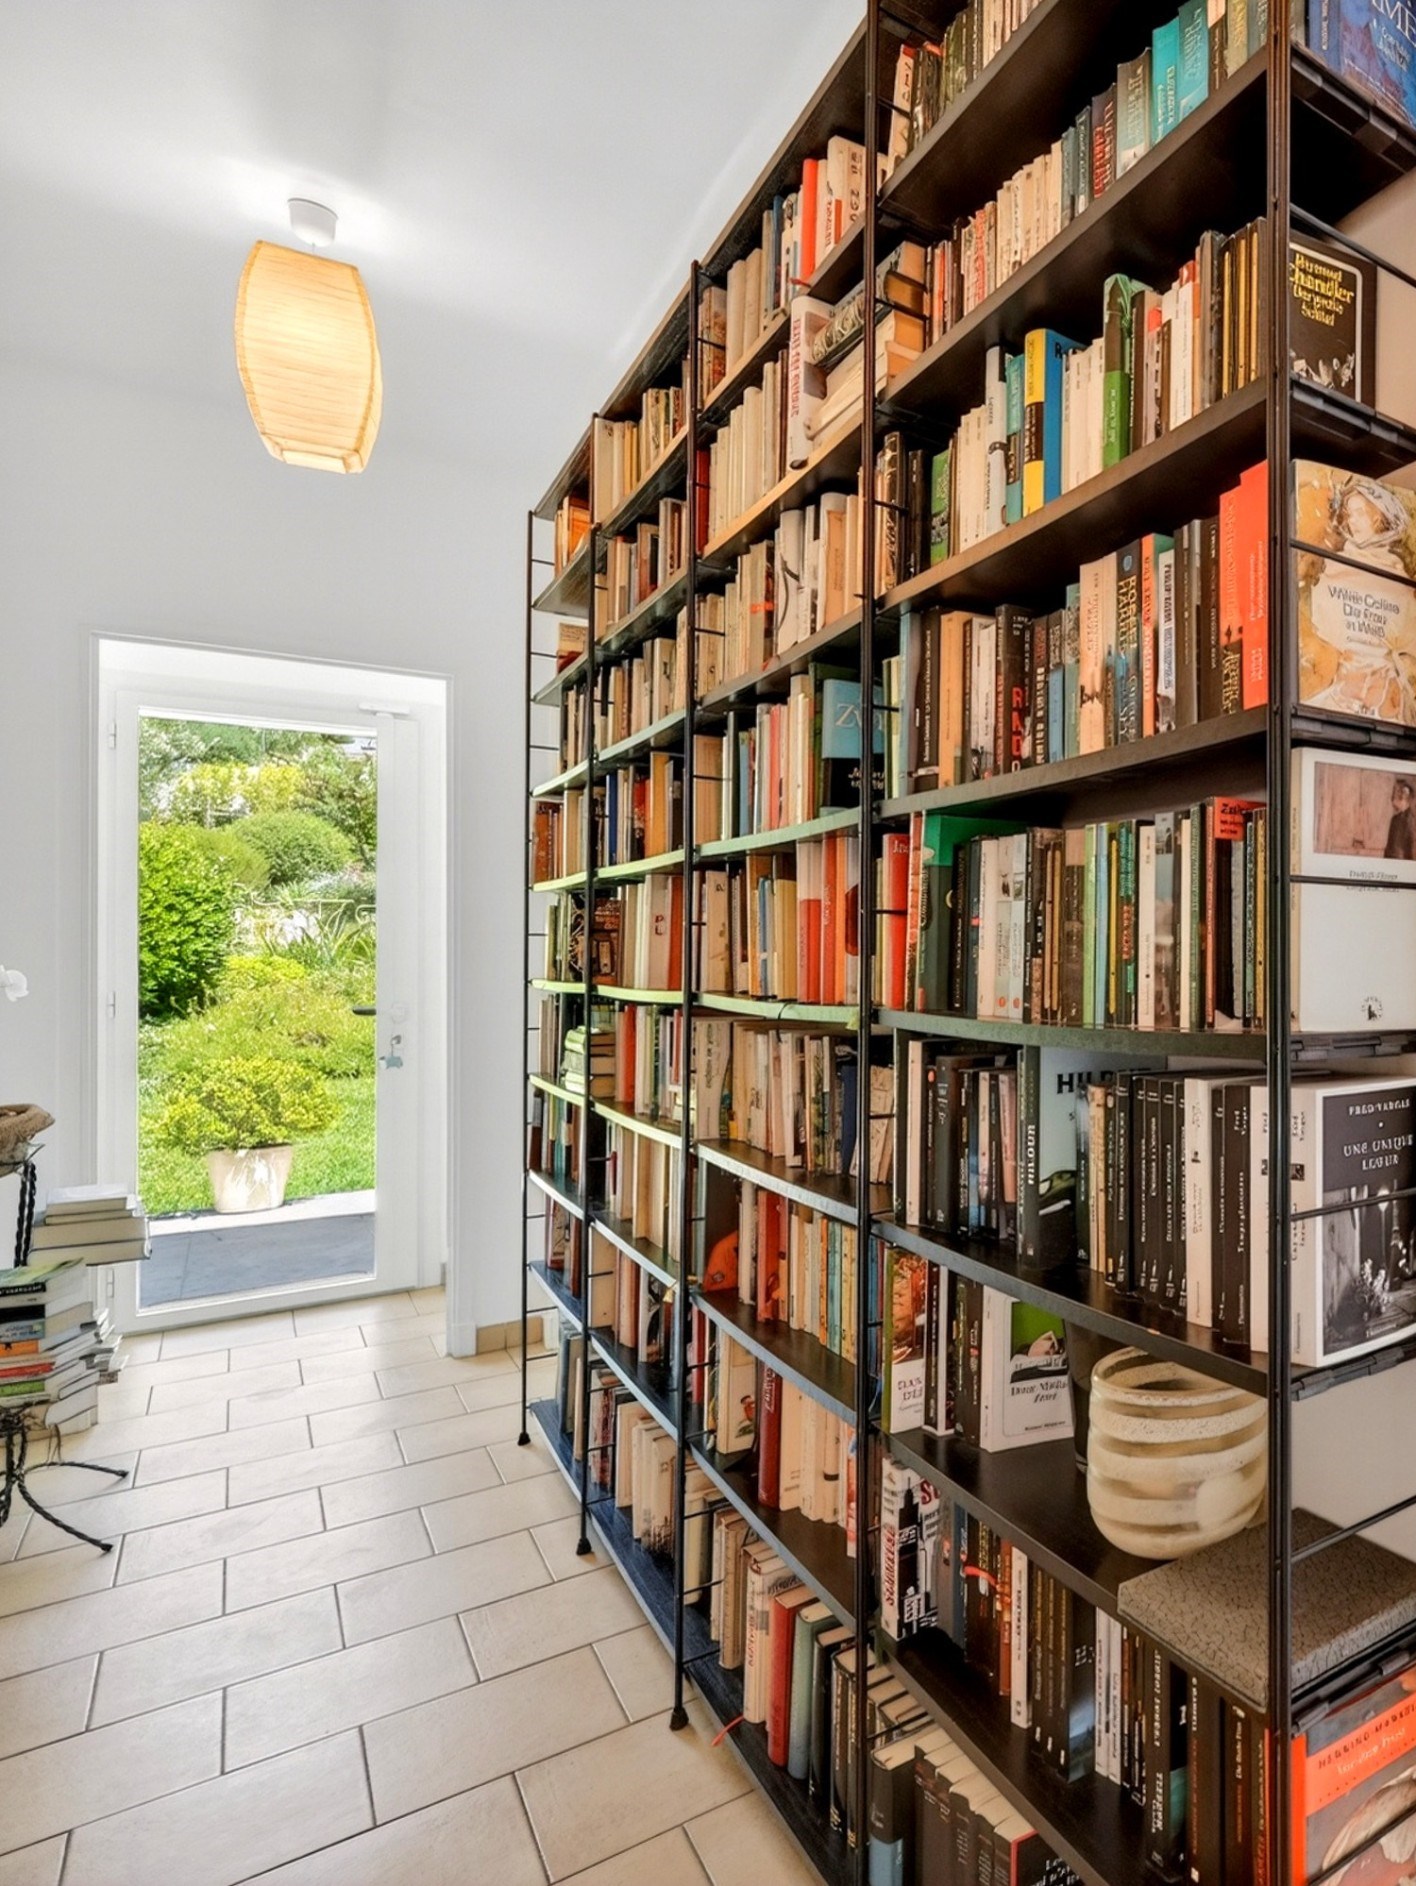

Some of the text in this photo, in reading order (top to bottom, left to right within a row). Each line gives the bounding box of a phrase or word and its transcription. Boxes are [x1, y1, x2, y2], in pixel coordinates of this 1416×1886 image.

[1348, 1098, 1411, 1116] FRED VARGAS
[1343, 1134, 1414, 1157] UNE UNIQUE
